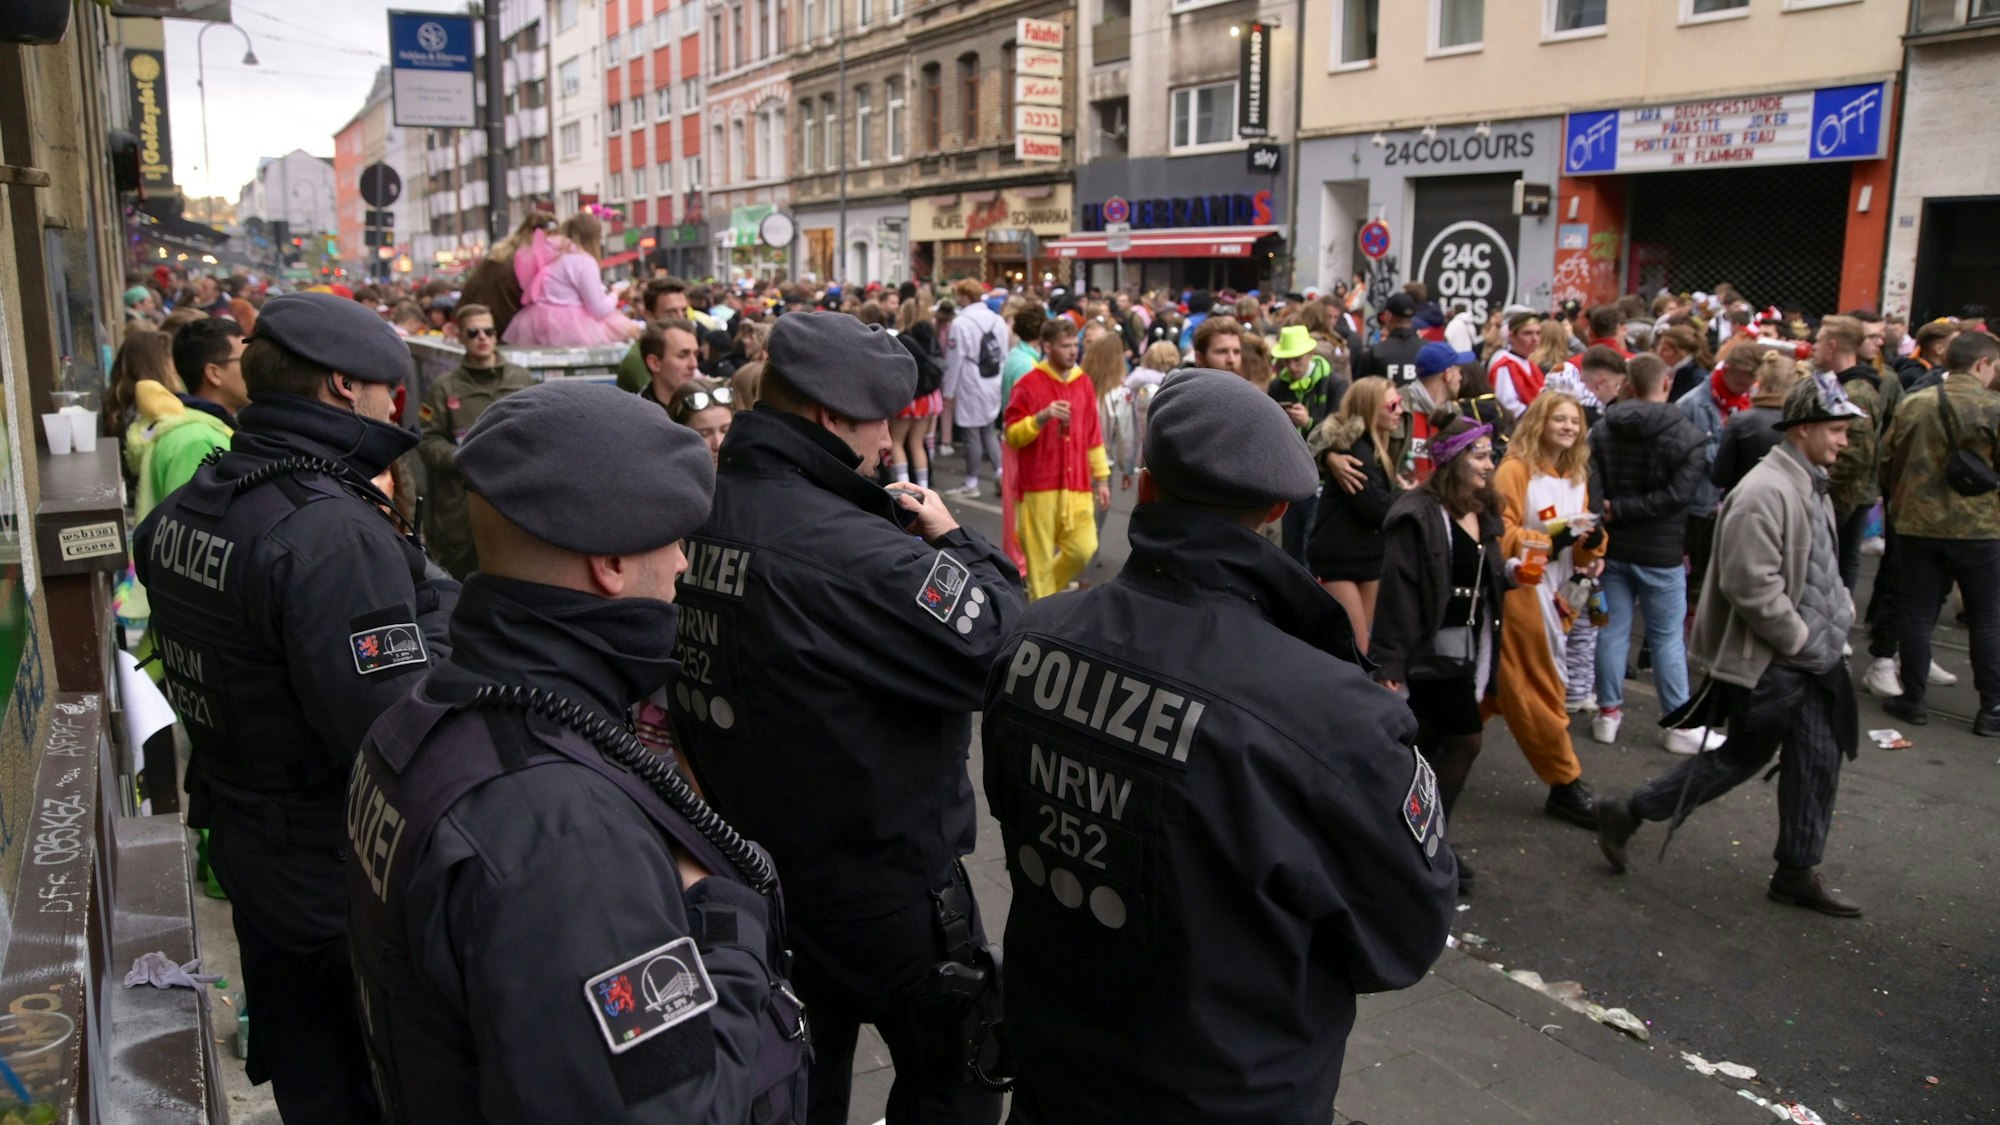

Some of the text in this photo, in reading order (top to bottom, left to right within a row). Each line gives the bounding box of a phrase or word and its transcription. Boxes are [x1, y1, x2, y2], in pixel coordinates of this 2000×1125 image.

[1662, 112, 1789, 134] PARASITE JOKER
[1674, 95, 1784, 119] DEUTSCHSTUNDE
[1816, 87, 1879, 156] OFF
[1384, 132, 1535, 166] 24COLOURS
[1568, 113, 1615, 171] OFF
[1634, 130, 1775, 152] PORTRAIT EINER FRAU
[1672, 147, 1754, 165] IN FLAMMEN
[1253, 149, 1278, 170] sky
[1441, 243, 1491, 269] 24C
[1438, 270, 1493, 296] OLO
[65, 541, 115, 557] Cesena
[151, 515, 234, 592] POLIZEI
[162, 634, 204, 684] NRW
[1004, 640, 1206, 763] POLIZEI
[1030, 743, 1133, 821] NRW
[348, 749, 406, 903] POLIZEI
[1039, 805, 1107, 870] 252
